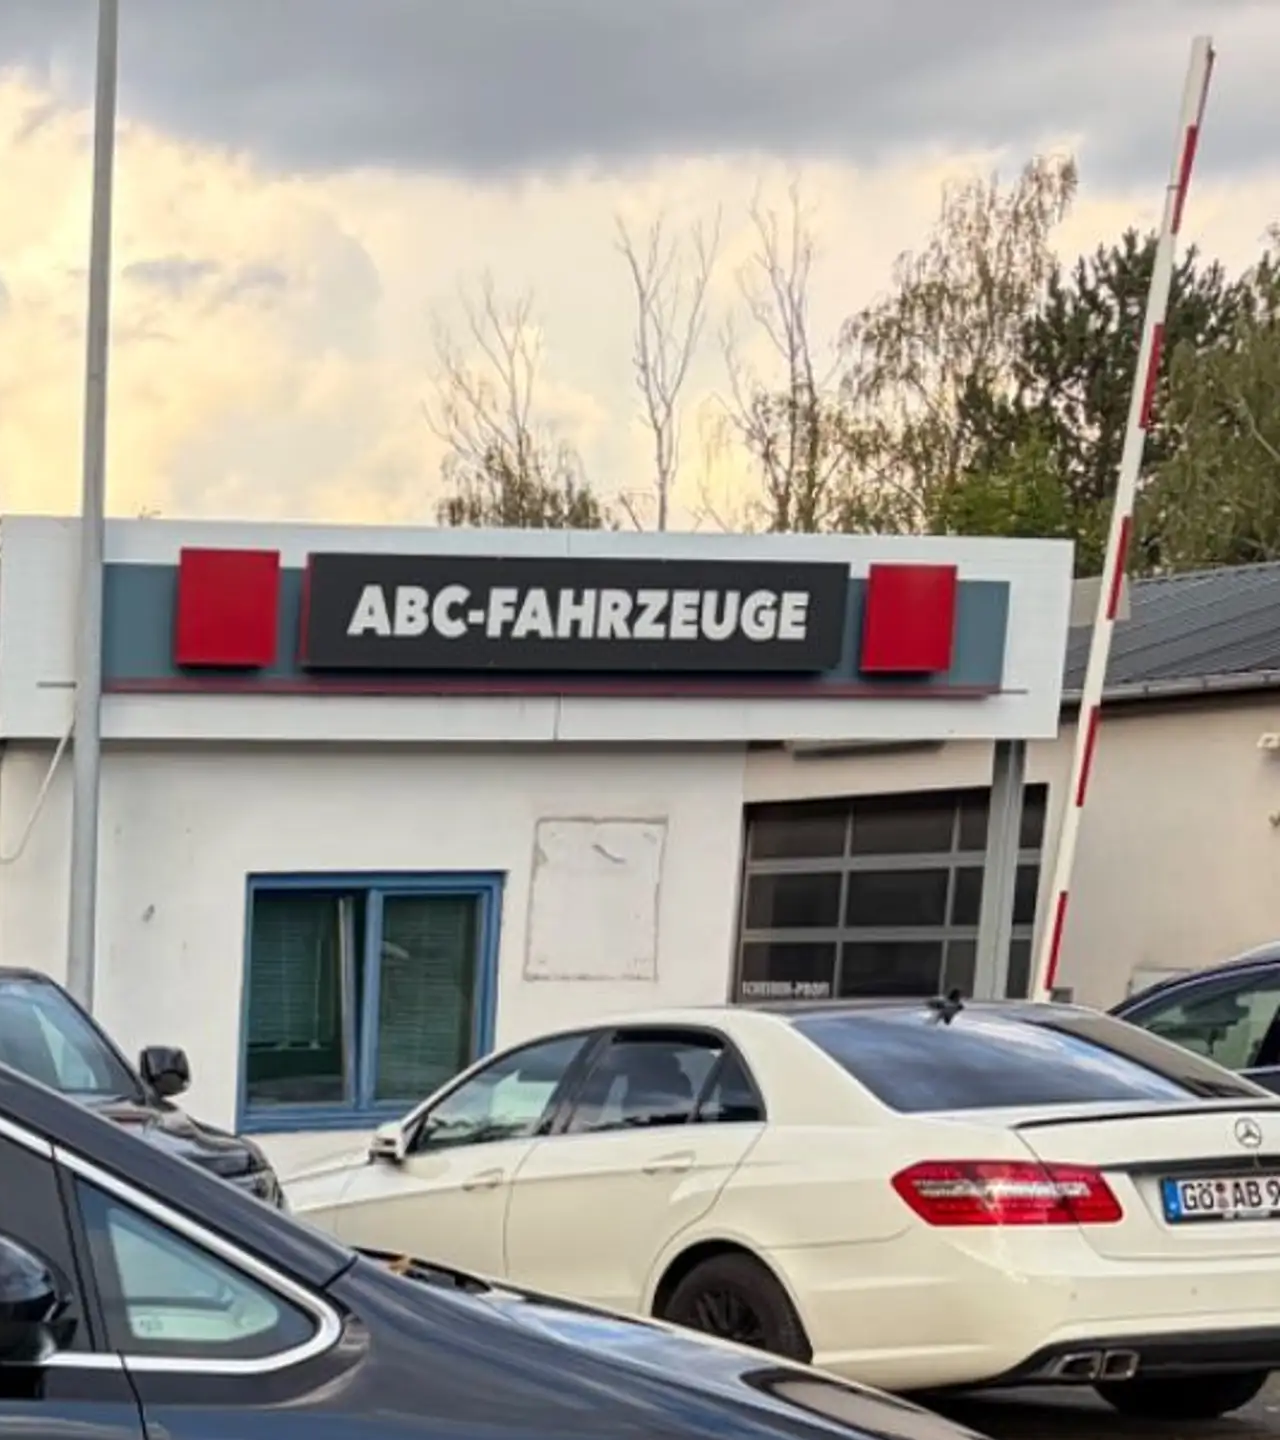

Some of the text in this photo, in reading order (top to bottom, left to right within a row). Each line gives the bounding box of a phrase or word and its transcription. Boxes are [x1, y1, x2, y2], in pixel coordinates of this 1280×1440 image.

[346, 584, 810, 642] ABC-FAHRZEUGE
[1181, 1182, 1215, 1210] GÖ
[1232, 1181, 1262, 1208] AB
